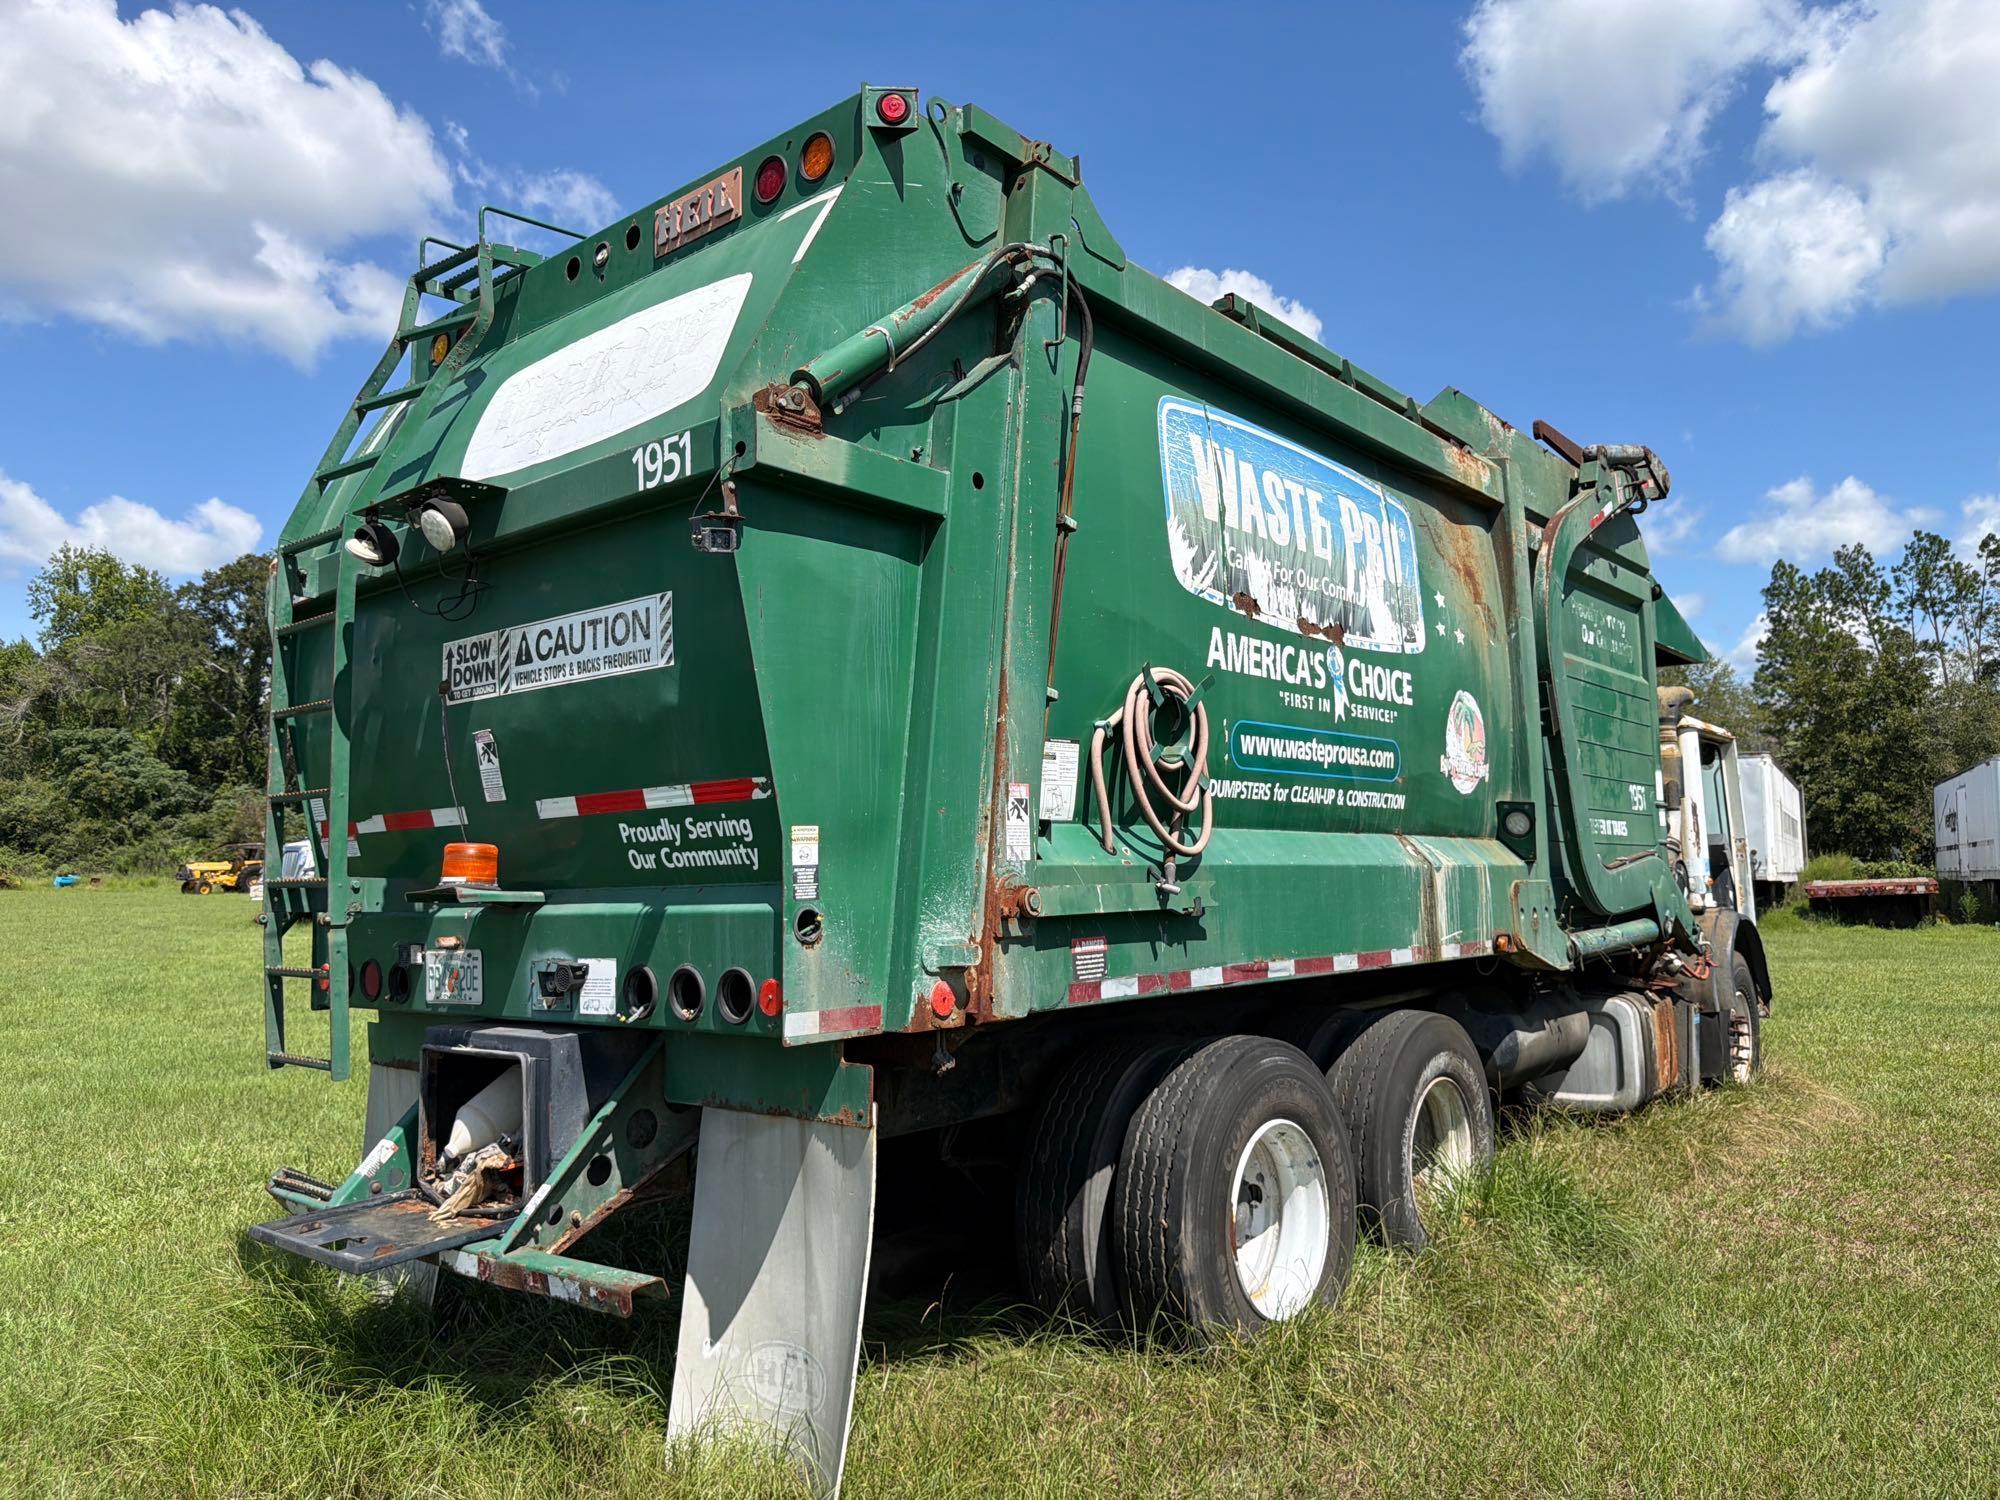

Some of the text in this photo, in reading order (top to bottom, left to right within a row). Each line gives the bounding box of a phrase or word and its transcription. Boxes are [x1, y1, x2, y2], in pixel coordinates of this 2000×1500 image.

[656, 181, 734, 246] HEIL
[631, 430, 691, 491] 1951
[1188, 431, 1334, 567] WASTE
[1273, 560, 1294, 584] For
[1297, 568, 1319, 592] Our
[535, 607, 651, 661] CAUTION
[456, 639, 493, 665] SLOW
[514, 647, 652, 687] VEHICLE STOPS & BACKS FREQUENTLY
[1206, 626, 1413, 706] AMERICA'S CHOICE
[453, 659, 496, 687] DOWN
[453, 684, 496, 699] TO GET AROUND
[1318, 697, 1331, 713] IN
[1240, 733, 1395, 769] www.wasteprousa.com
[1208, 778, 1406, 810] DUMPSTERS for CLEAN-UP & CONSTRUCTION
[618, 813, 753, 846] Proudly Serving
[628, 841, 759, 871] Our Community
